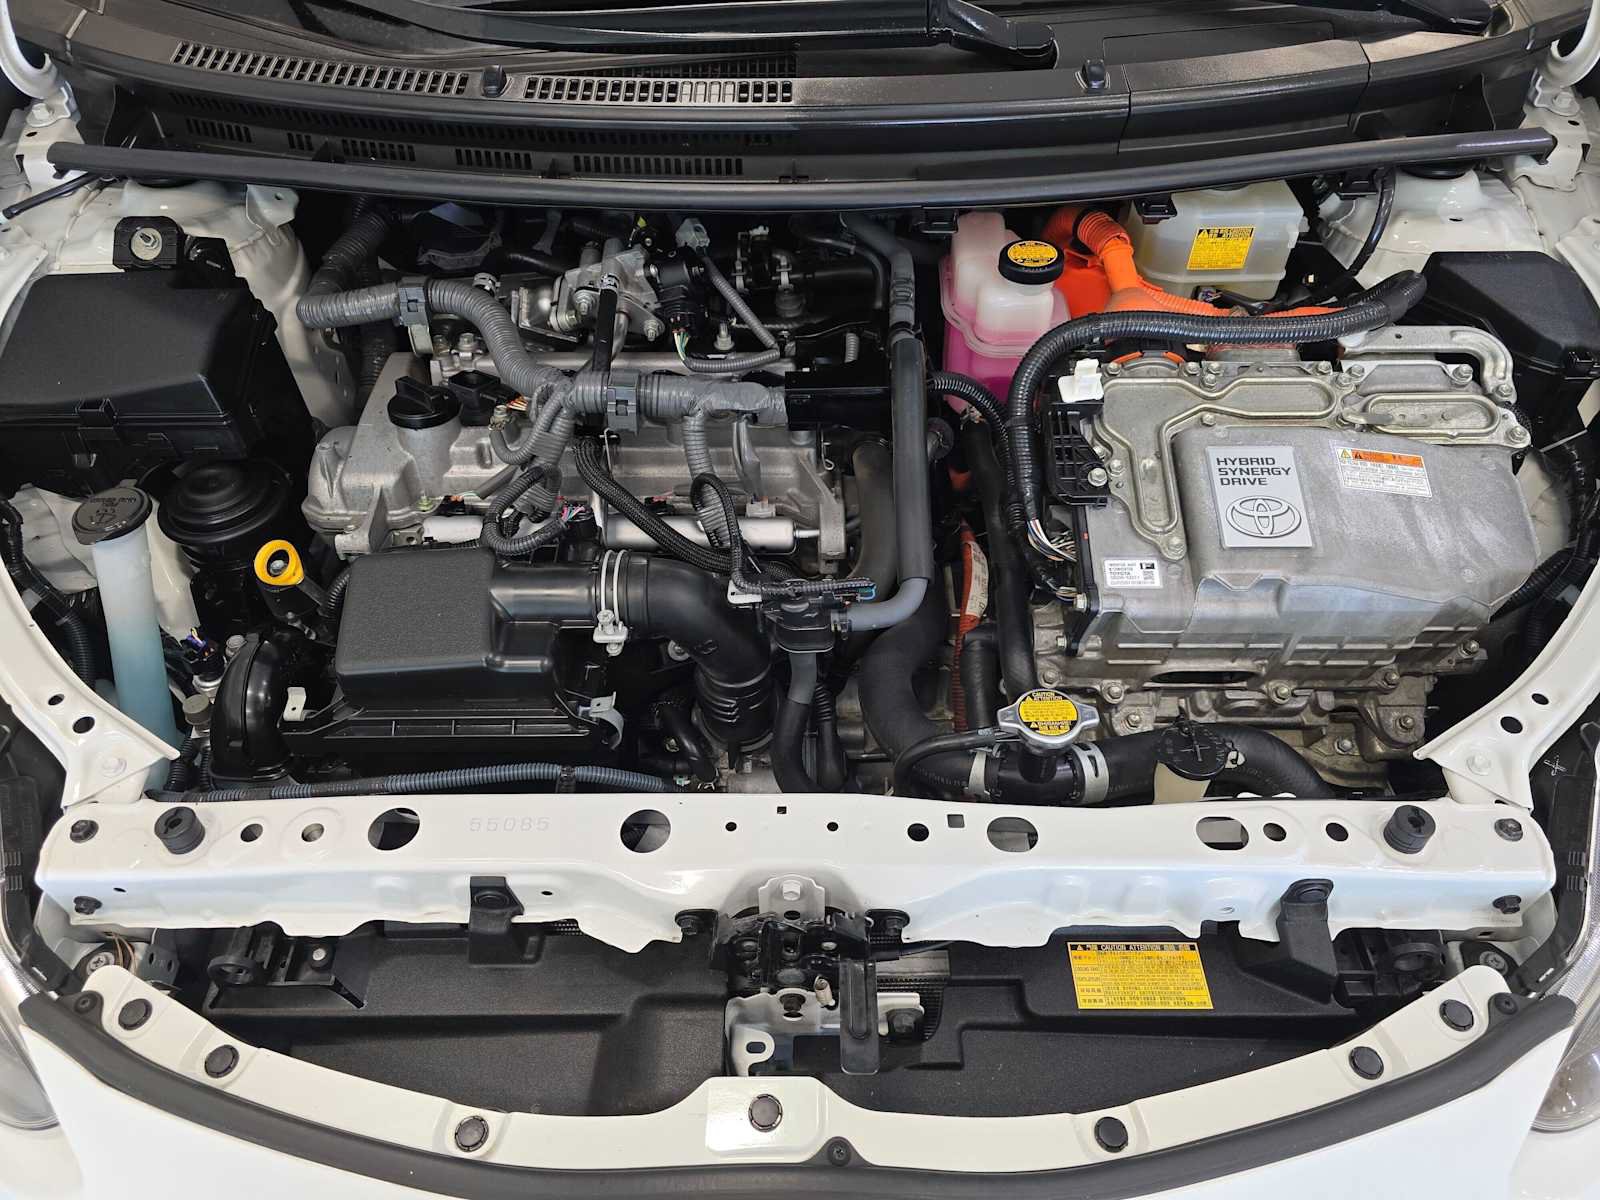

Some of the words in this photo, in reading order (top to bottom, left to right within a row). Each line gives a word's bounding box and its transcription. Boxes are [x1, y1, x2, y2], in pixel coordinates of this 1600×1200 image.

[1216, 457, 1276, 466] HYBRID
[1218, 467, 1291, 476] SYNERGY
[1220, 477, 1268, 486] DRIVE
[469, 816, 551, 832] 55085
